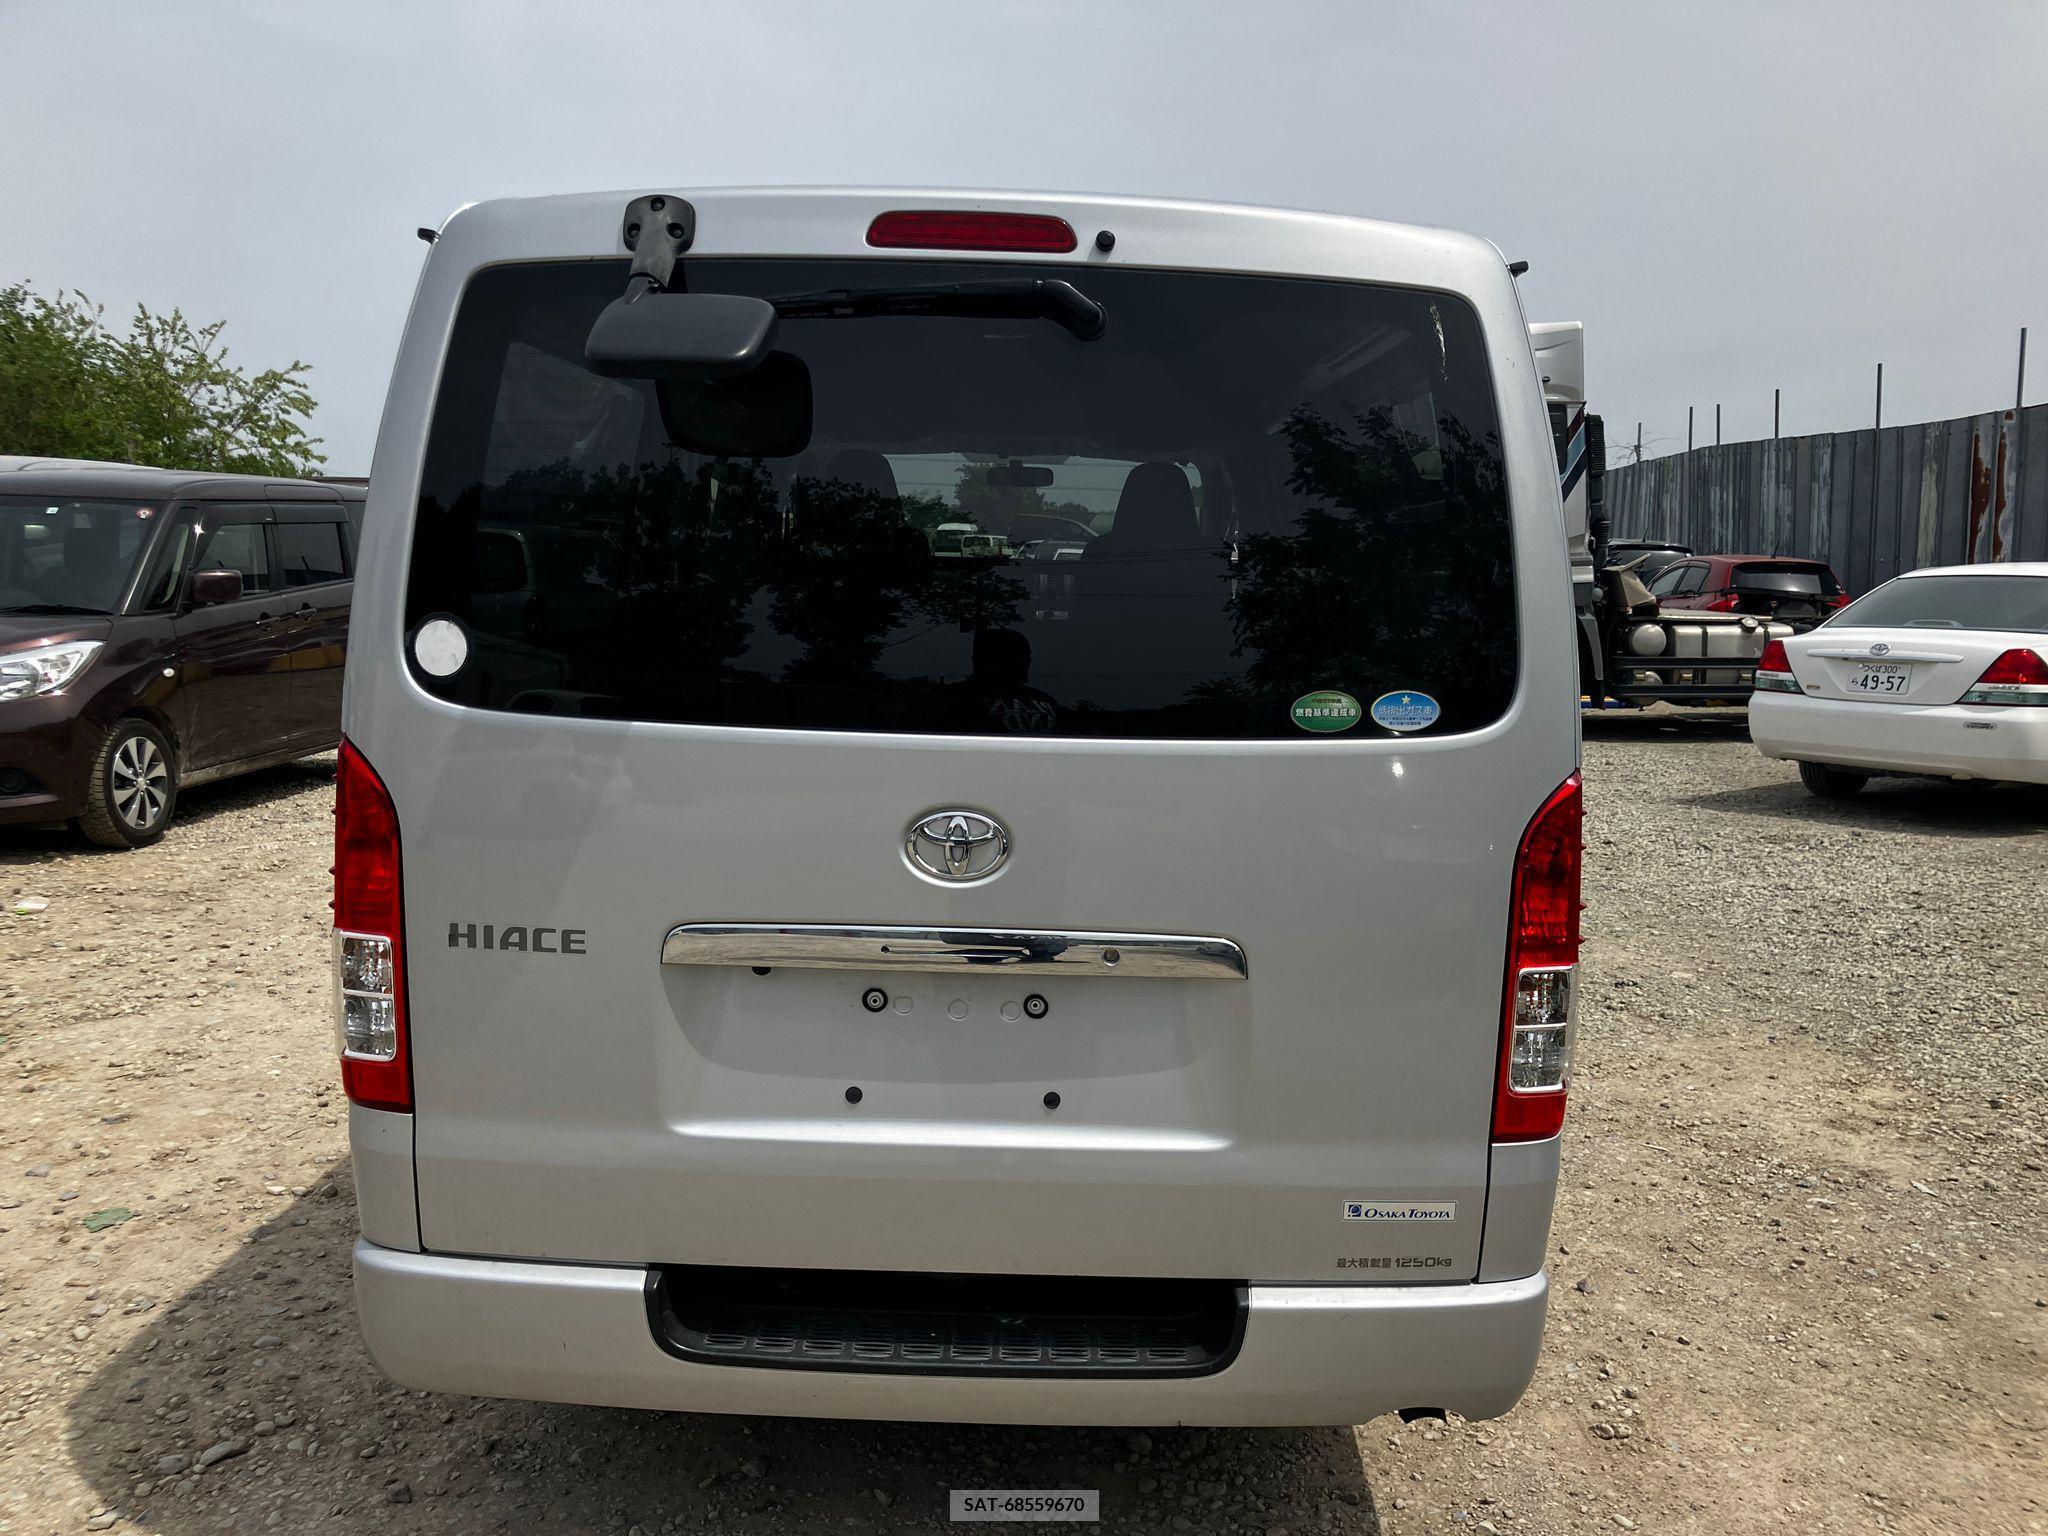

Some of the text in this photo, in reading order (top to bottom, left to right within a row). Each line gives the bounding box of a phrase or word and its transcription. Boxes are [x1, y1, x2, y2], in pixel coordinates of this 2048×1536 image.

[1860, 674, 1906, 692] 49-57
[448, 922, 587, 955] HIACE
[1364, 1208, 1450, 1219] OSAKA TOYOTA
[1395, 1256, 1453, 1269] 1250kg
